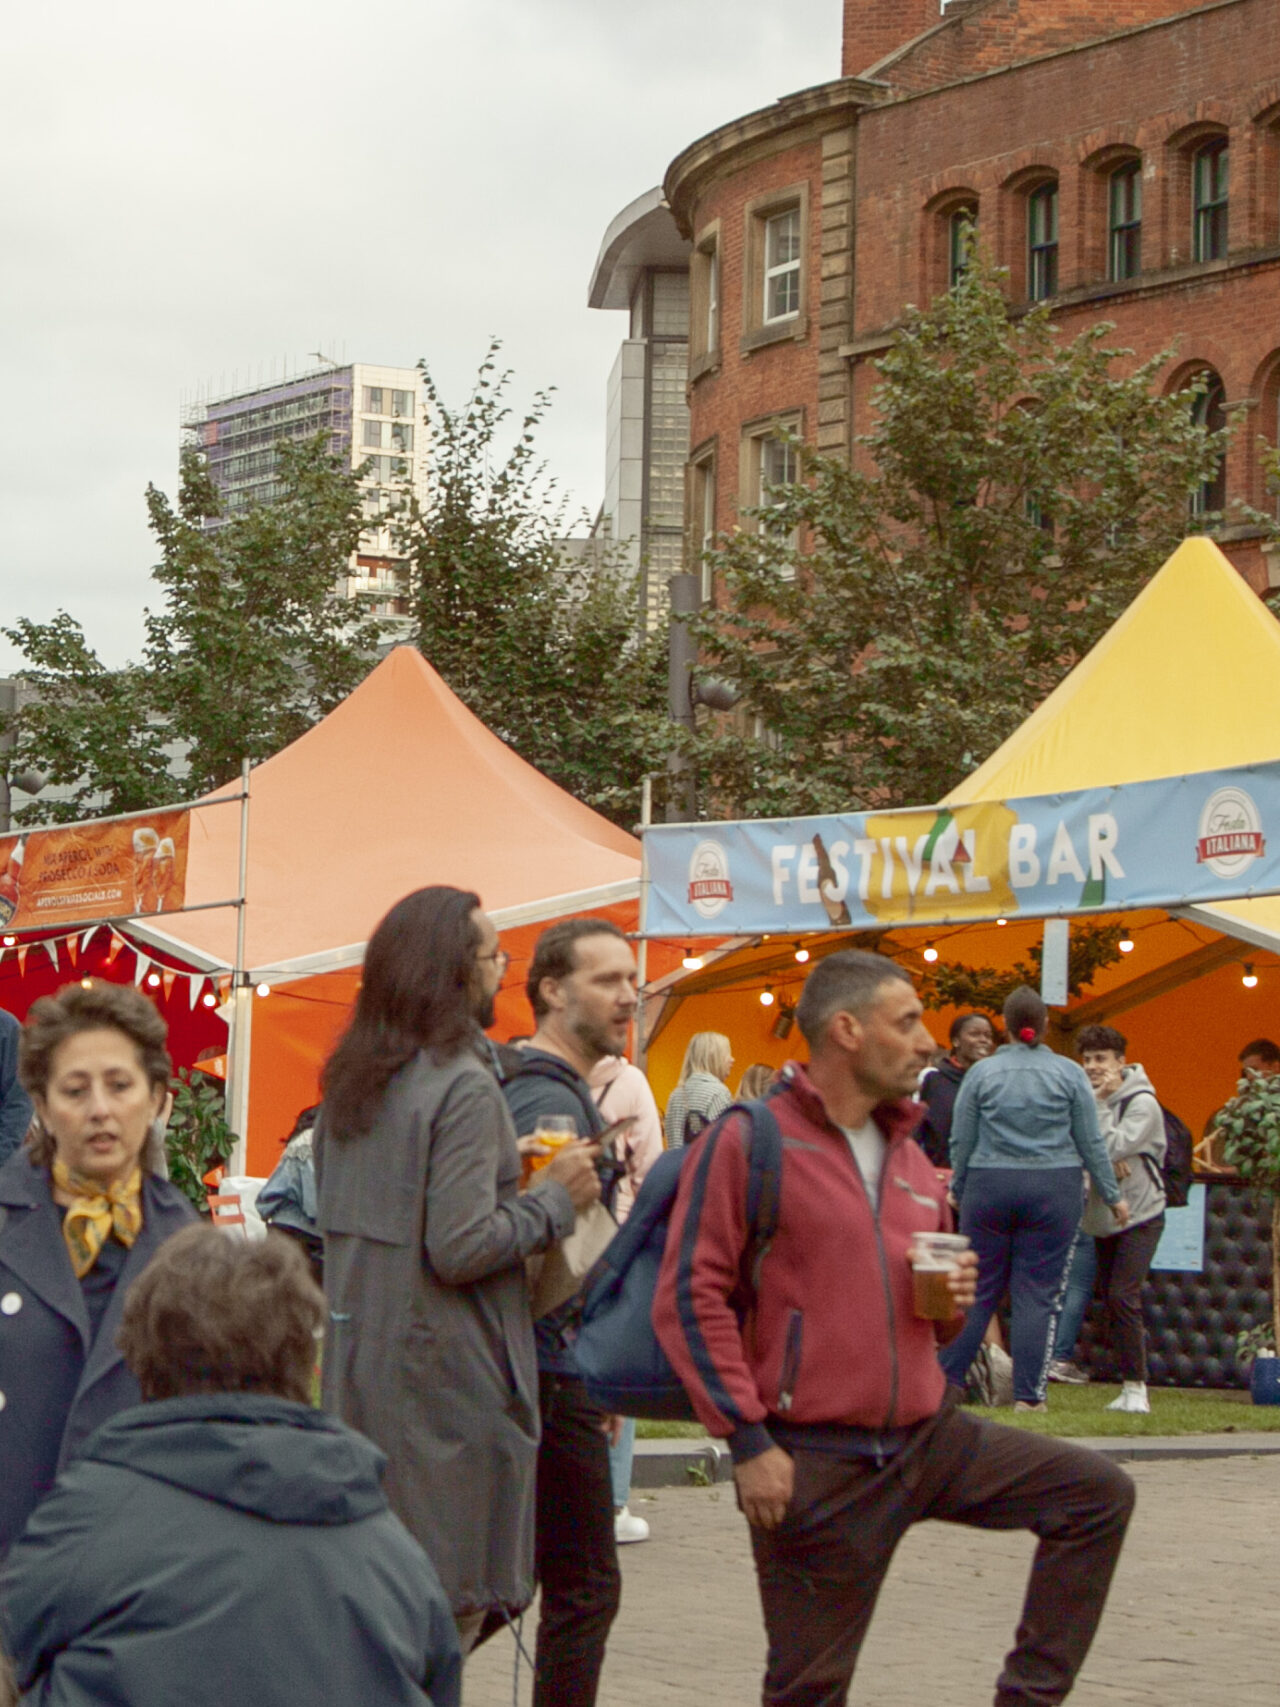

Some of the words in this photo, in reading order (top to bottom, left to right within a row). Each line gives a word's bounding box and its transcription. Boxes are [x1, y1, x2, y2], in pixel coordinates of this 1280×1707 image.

[1205, 834, 1257, 856] ITALIANA
[771, 822, 992, 906] FESTIVAL
[1008, 813, 1126, 890] BAR
[693, 881, 728, 898] ITALIANA
